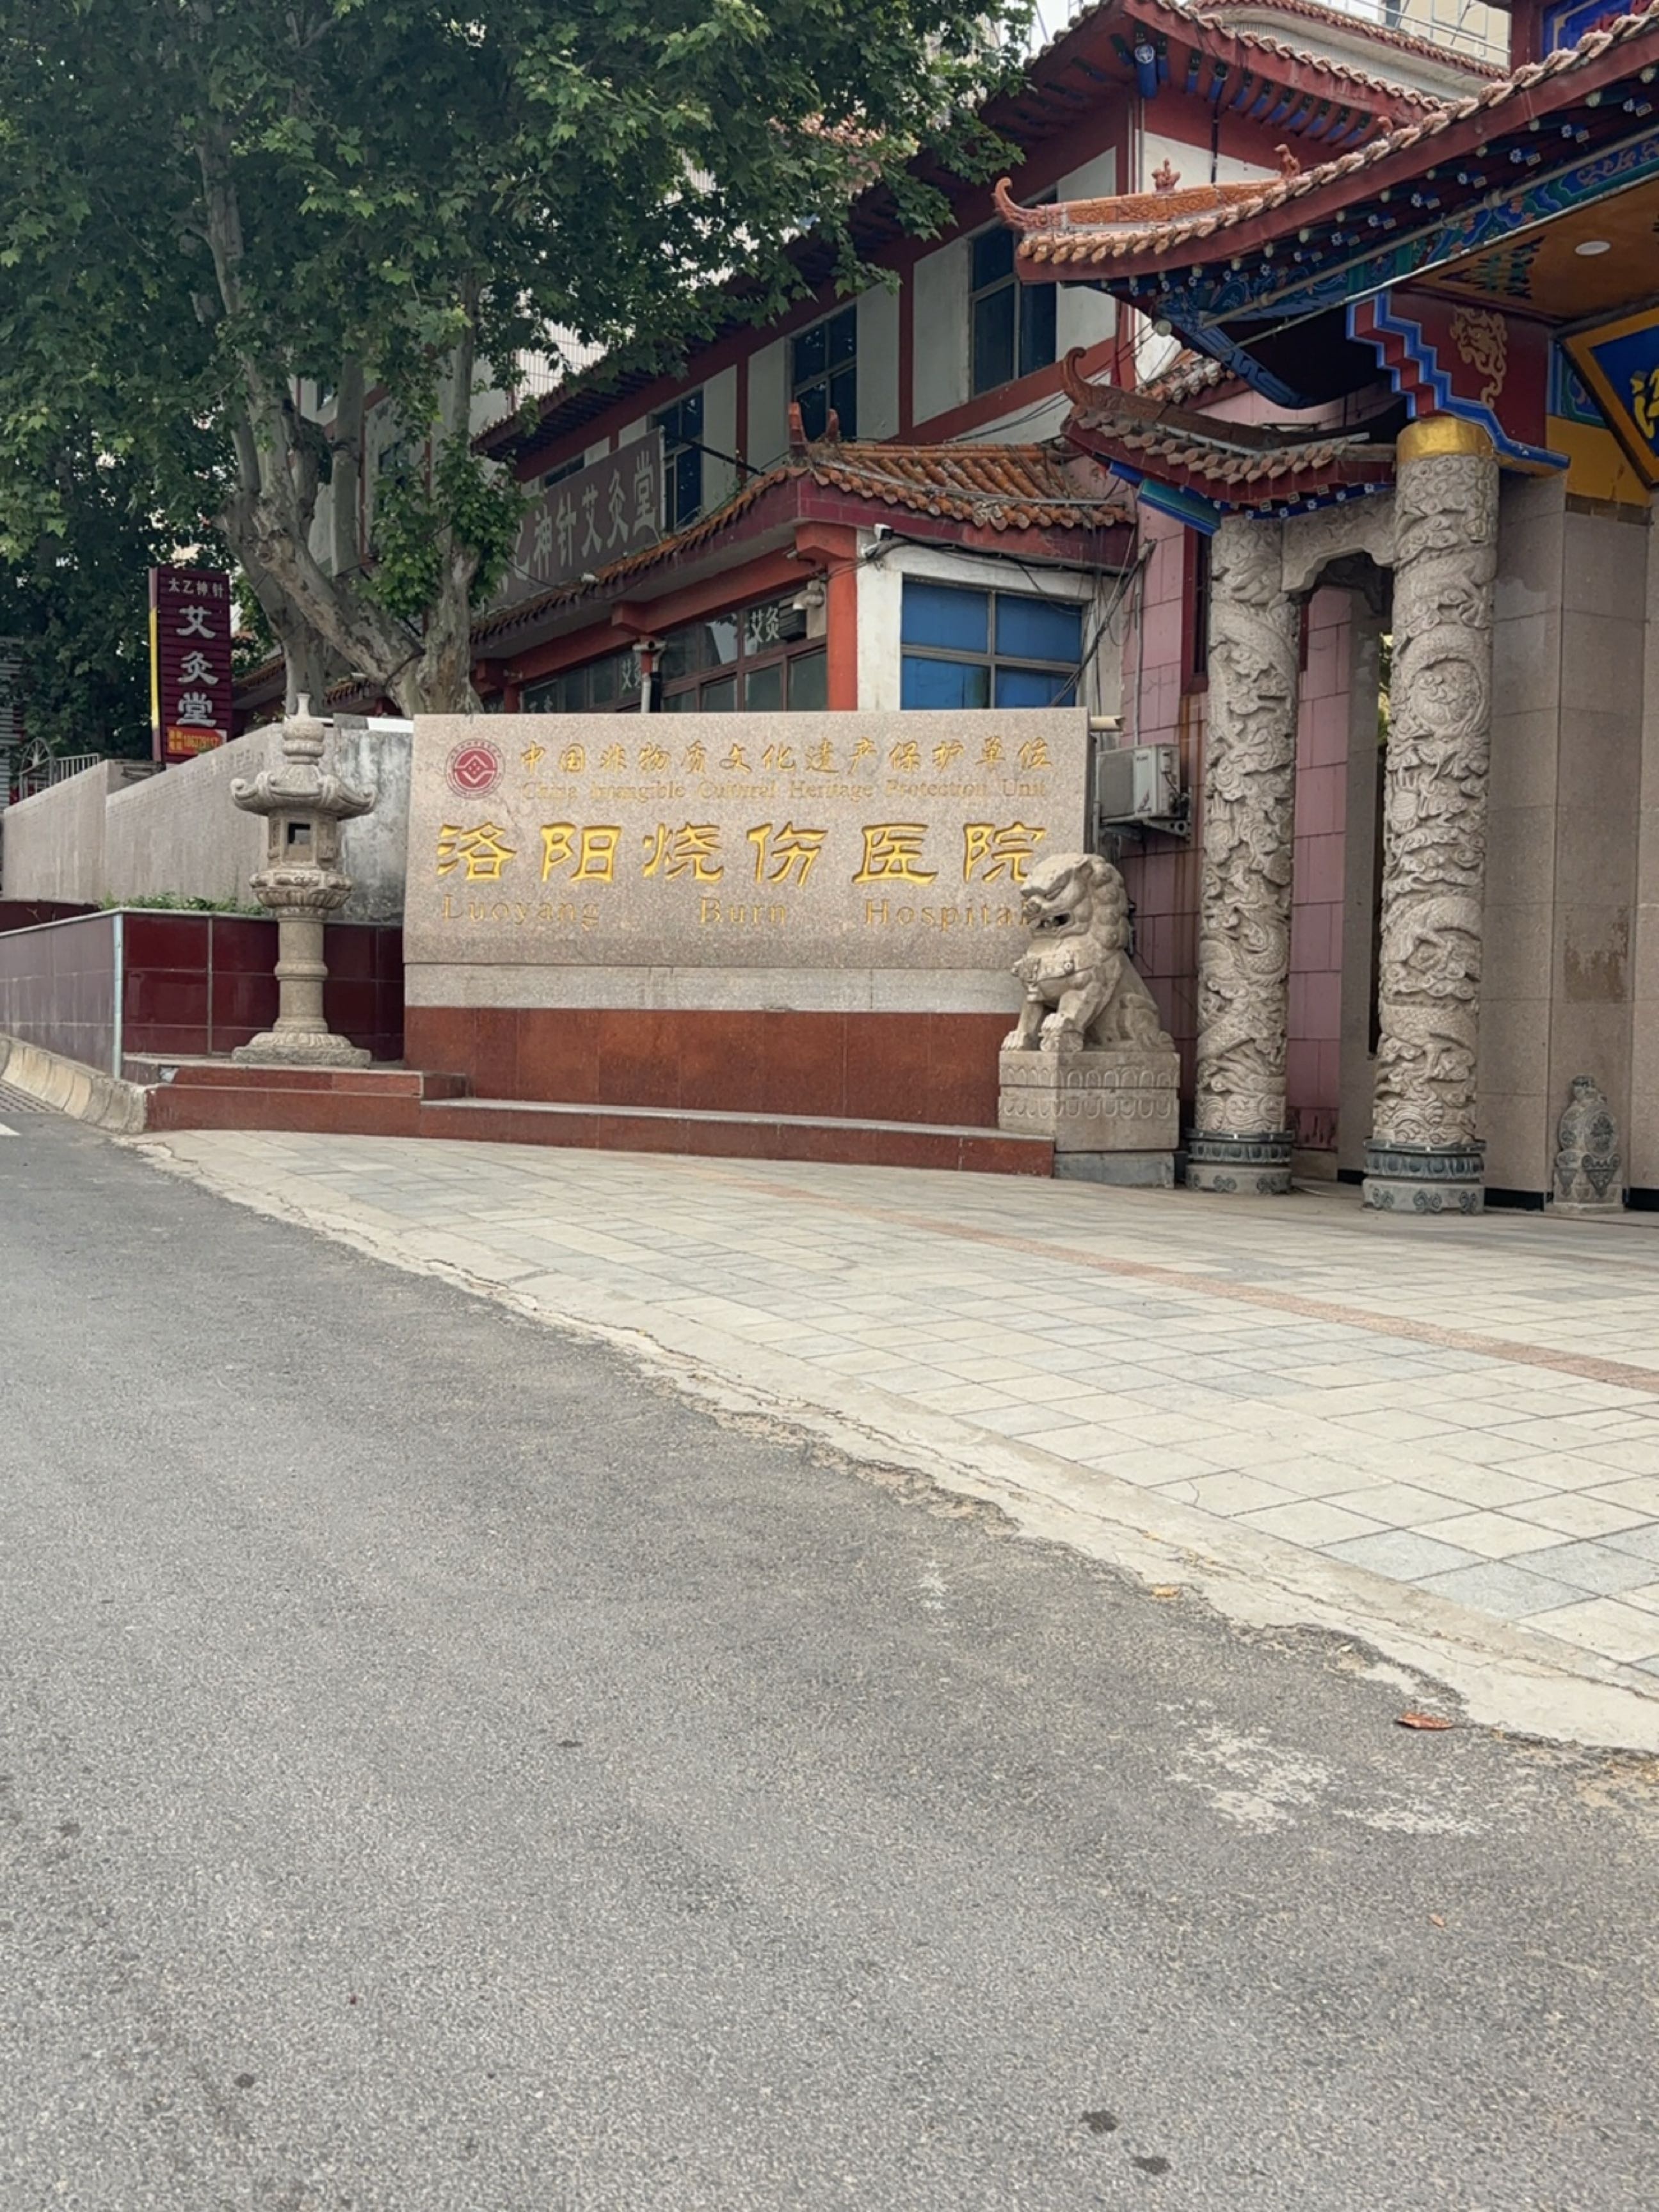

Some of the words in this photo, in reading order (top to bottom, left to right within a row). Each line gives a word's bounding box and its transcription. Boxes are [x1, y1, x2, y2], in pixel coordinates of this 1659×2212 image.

[168, 577, 223, 598] 太乙神针
[751, 606, 780, 643] 艾灸
[176, 605, 219, 728] 艾灸堂
[520, 735, 1054, 774] 中国非物质文化遗产保护单位
[522, 781, 577, 801] China
[590, 780, 686, 803] Intangible
[698, 780, 776, 799] Cultural
[790, 779, 873, 802] Heritage
[885, 778, 987, 799] Protection
[1001, 778, 1047, 797] Unit
[437, 821, 1048, 887] 洛阳烧伤医院
[441, 894, 600, 931] Luoyang
[700, 895, 786, 924] Burn
[863, 897, 1030, 933] Hospital
